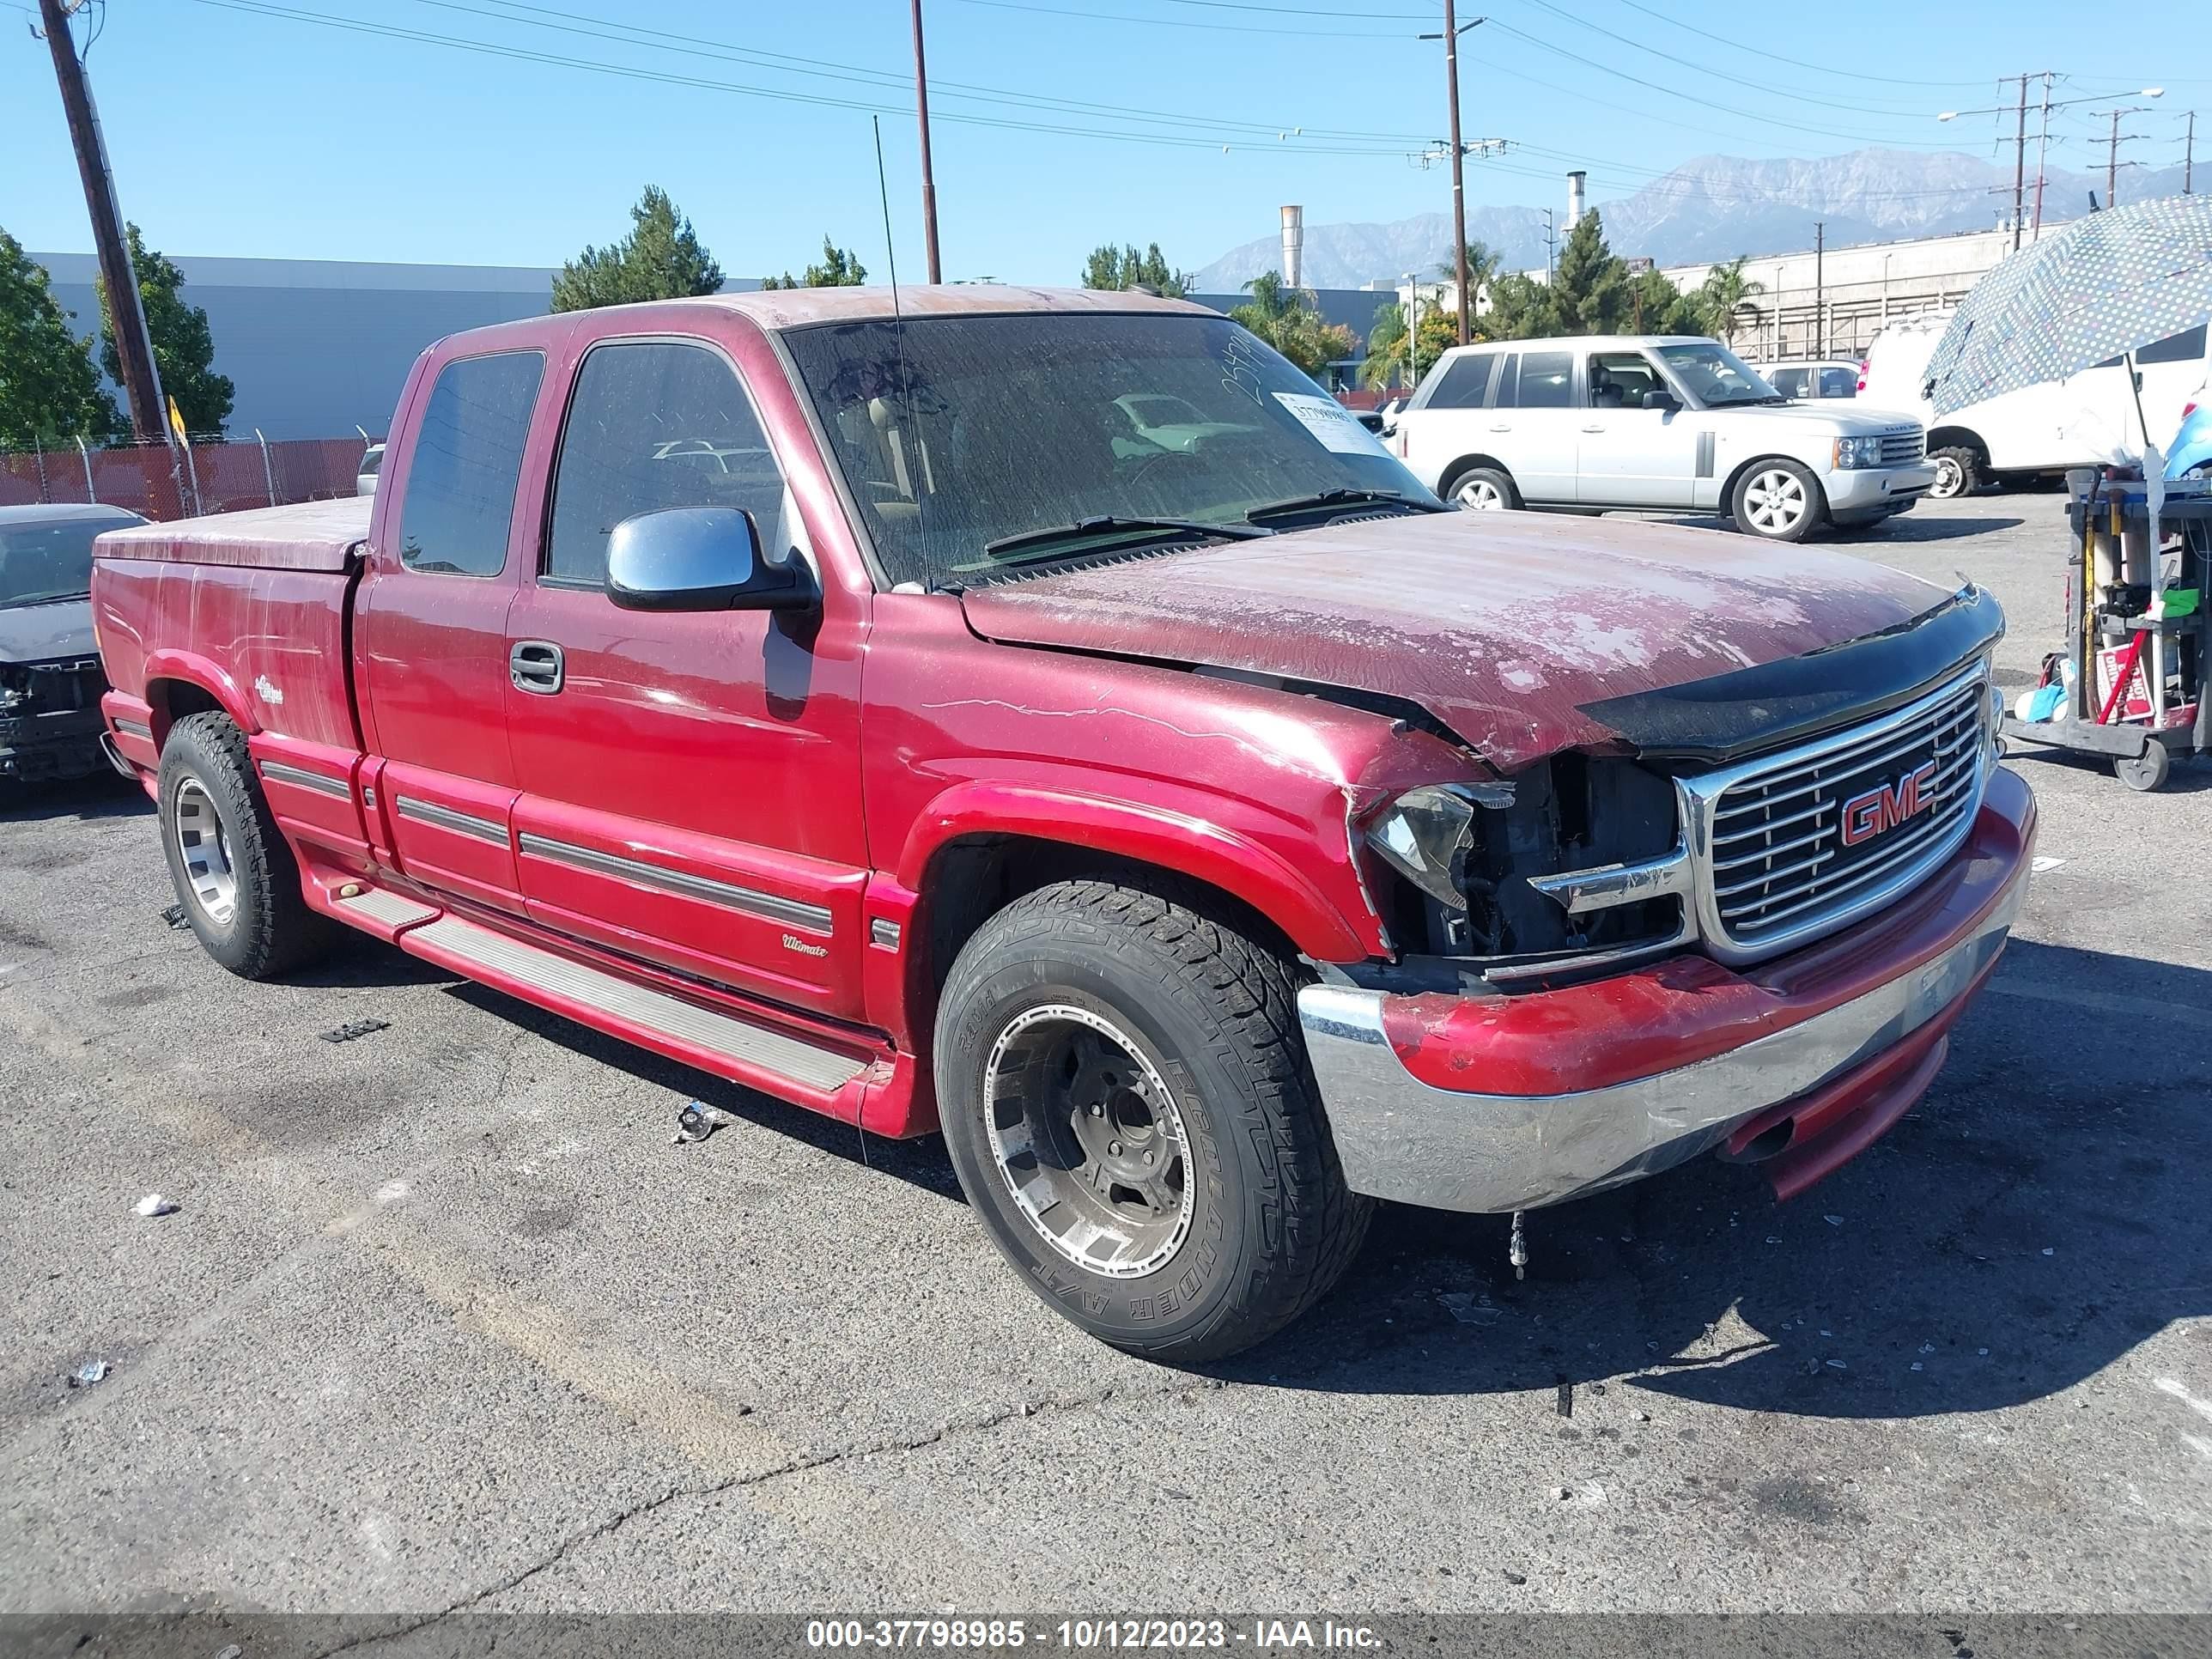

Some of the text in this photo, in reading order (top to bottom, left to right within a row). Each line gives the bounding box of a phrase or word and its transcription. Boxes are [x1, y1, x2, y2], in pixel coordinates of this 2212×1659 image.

[1293, 405, 1352, 422] 37798985
[2131, 678, 2146, 701] NOT
[1842, 759, 1937, 848] GMC
[782, 933, 829, 957] Ultimate
[958, 990, 995, 1058] Rapid
[1177, 1131, 1192, 1213] PRO COMP XTREME
